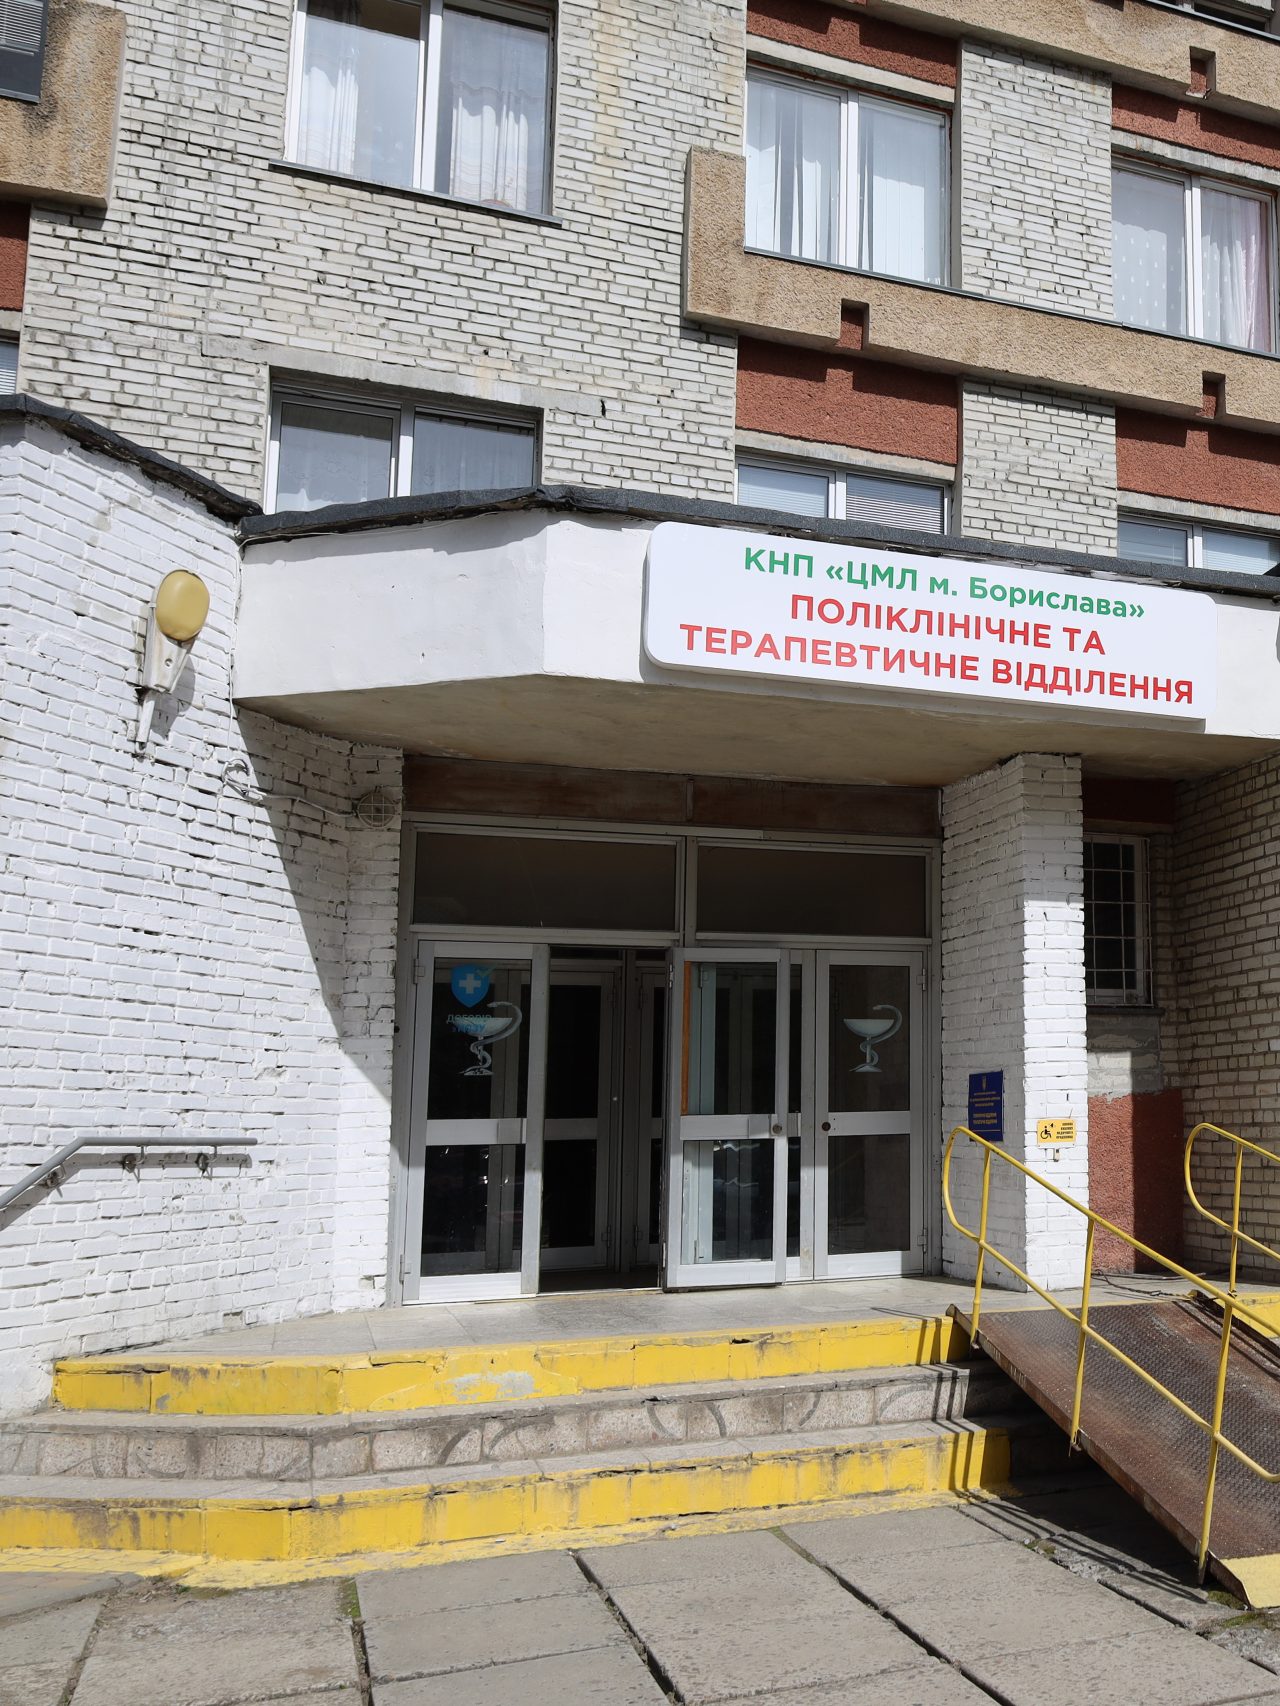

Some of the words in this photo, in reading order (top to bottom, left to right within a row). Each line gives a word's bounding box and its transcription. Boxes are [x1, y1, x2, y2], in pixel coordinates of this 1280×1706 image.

[745, 547, 813, 577] КНП
[826, 561, 917, 591] «ЦМЛ
[930, 577, 957, 597] м.
[970, 577, 1145, 619] Борислава»
[791, 594, 1052, 649] ПОЛІКЛІНІЧНЕ
[1062, 626, 1105, 655] ТА
[679, 623, 979, 681] ТЕРАПЕВТИЧНЕ
[992, 658, 1193, 704] ВІДДІЛЕННЯ
